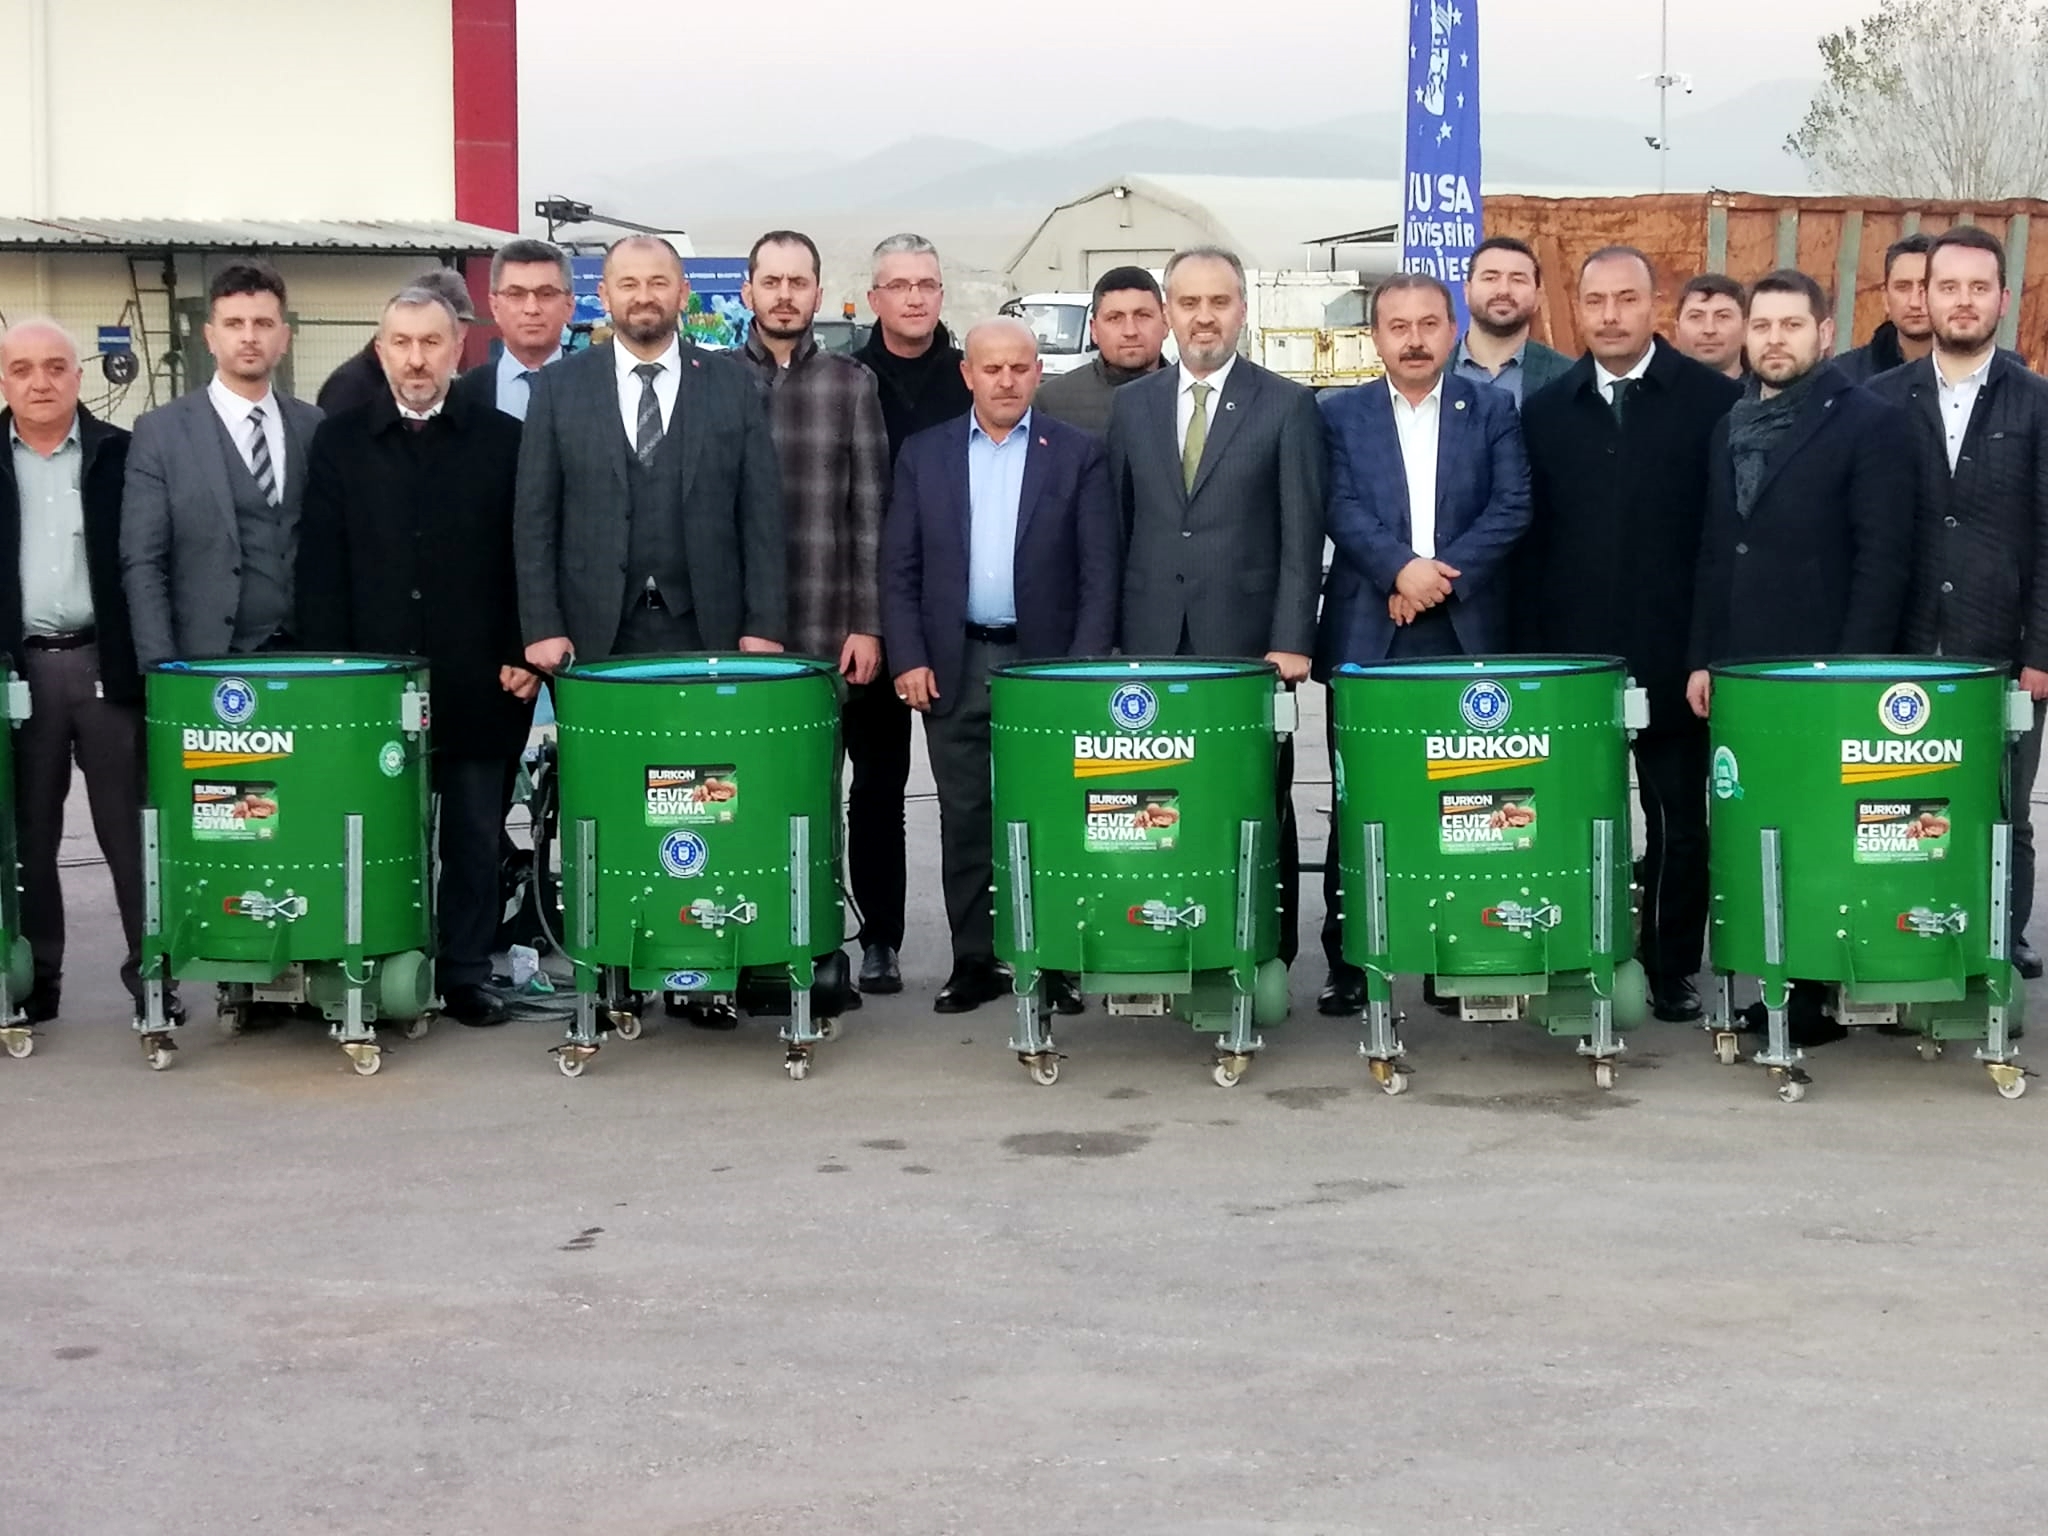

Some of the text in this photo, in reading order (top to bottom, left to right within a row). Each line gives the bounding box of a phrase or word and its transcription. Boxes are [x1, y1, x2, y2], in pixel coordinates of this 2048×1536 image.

[183, 729, 293, 752] BURKON
[1074, 736, 1195, 759] BURKON
[1426, 734, 1549, 759] BURKON
[1841, 739, 1962, 763] BURKON
[648, 770, 695, 780] BURKON
[1089, 795, 1137, 805] BURKON
[1443, 795, 1492, 806] BURKON
[647, 801, 705, 815] SOYMA
[1860, 804, 1911, 815] BURKON
[1087, 827, 1147, 841] SOYMA
[1442, 828, 1503, 842] SOYMA
[1857, 838, 1919, 852] SOYMA
